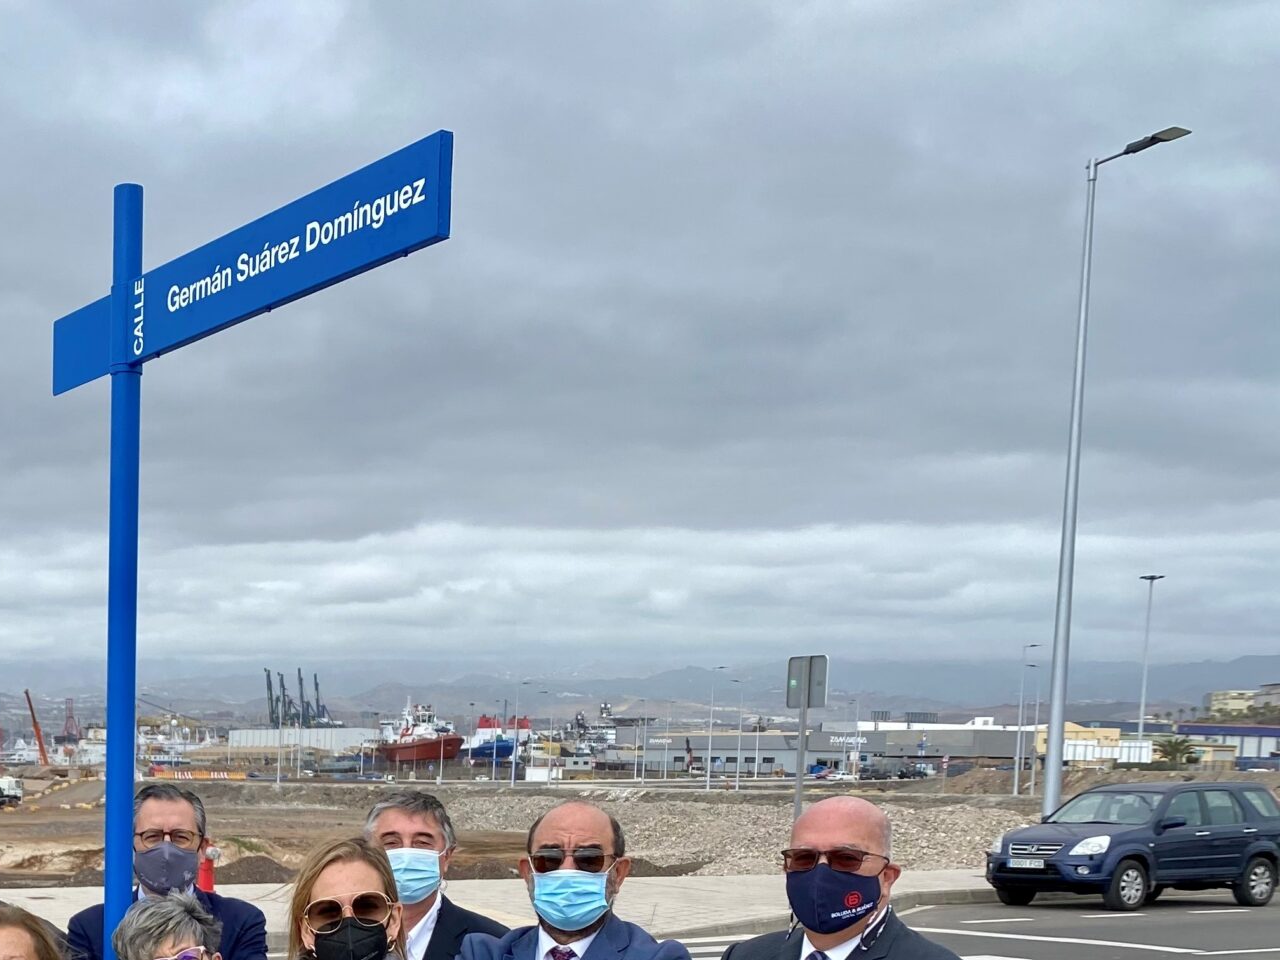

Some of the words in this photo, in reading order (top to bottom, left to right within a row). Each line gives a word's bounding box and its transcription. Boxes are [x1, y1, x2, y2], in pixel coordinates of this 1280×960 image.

[167, 265, 232, 313] Germán
[236, 235, 300, 282] Suárez
[305, 178, 426, 252] Domínguez
[133, 277, 145, 356] CALLE
